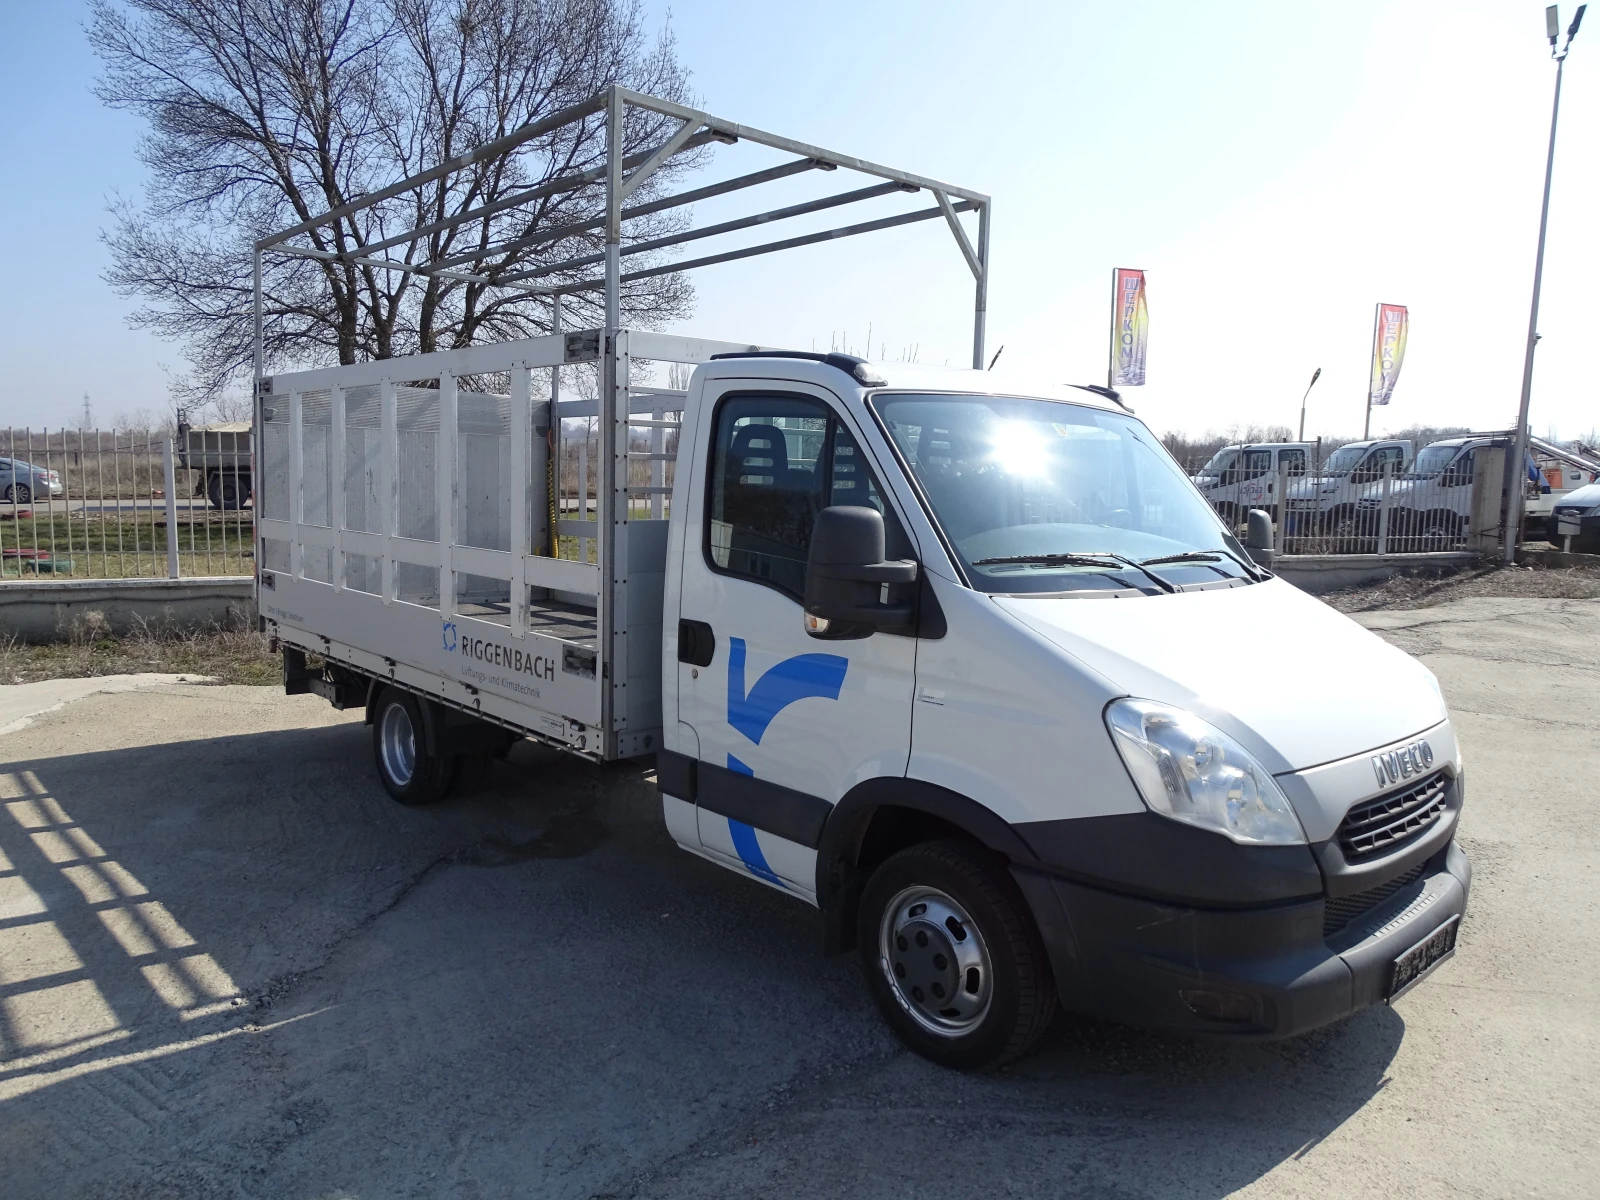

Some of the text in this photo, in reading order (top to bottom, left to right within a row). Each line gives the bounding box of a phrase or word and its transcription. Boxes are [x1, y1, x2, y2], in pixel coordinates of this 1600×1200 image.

[461, 665, 541, 699] Lüftungs- und Klimatechnik
[462, 635, 555, 682] RIGGENBACH
[1371, 739, 1433, 788] IVECO
